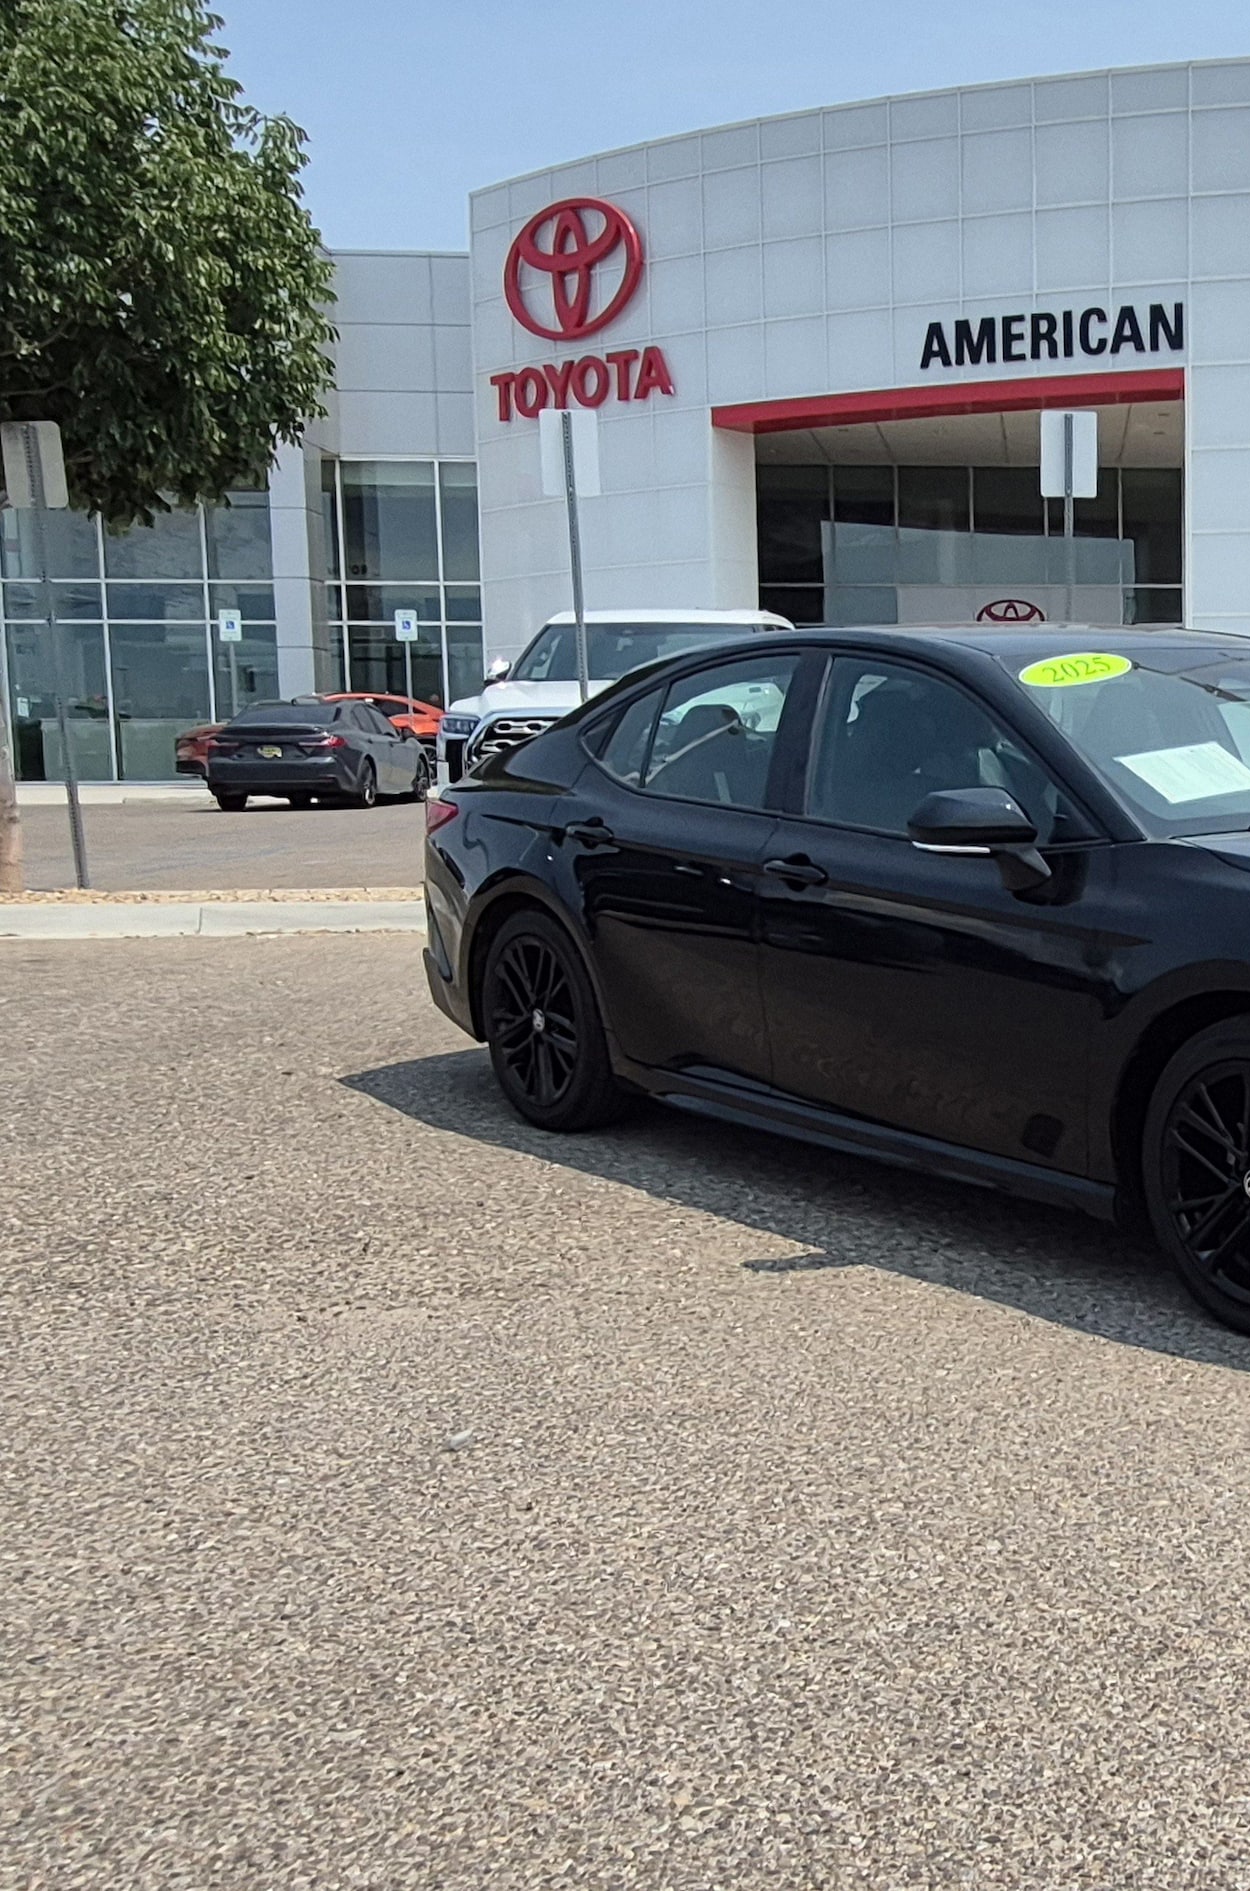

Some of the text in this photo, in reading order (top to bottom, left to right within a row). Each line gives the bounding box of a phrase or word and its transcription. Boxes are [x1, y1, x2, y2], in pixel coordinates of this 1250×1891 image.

[920, 302, 1184, 369] AMERICAN
[490, 346, 675, 422] TOYOTA
[1042, 657, 1111, 682] 2025
